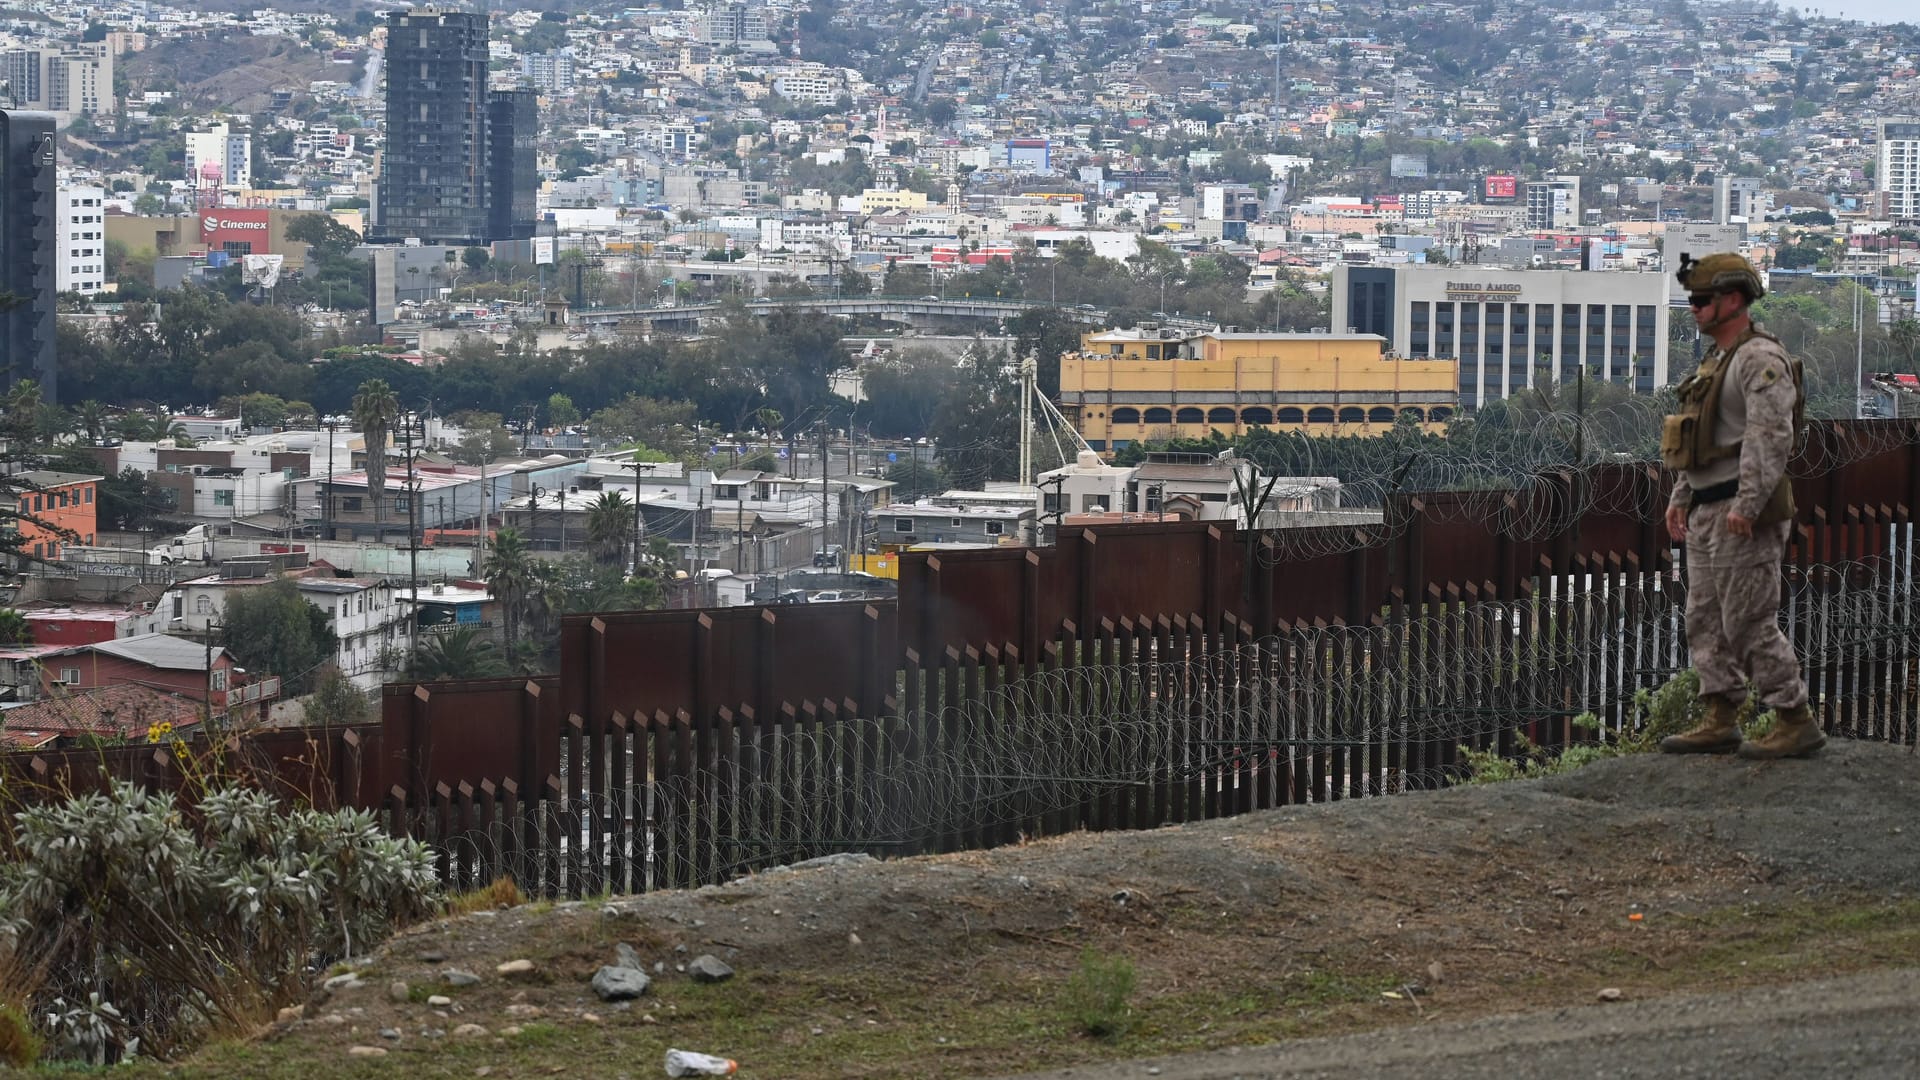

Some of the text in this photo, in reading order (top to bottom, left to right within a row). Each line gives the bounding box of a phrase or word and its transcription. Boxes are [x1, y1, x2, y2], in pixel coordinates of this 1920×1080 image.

[220, 219, 267, 229] Cinemex
[1447, 281, 1521, 292] PUEBLO AMIGO
[1486, 294, 1517, 302] CASINO
